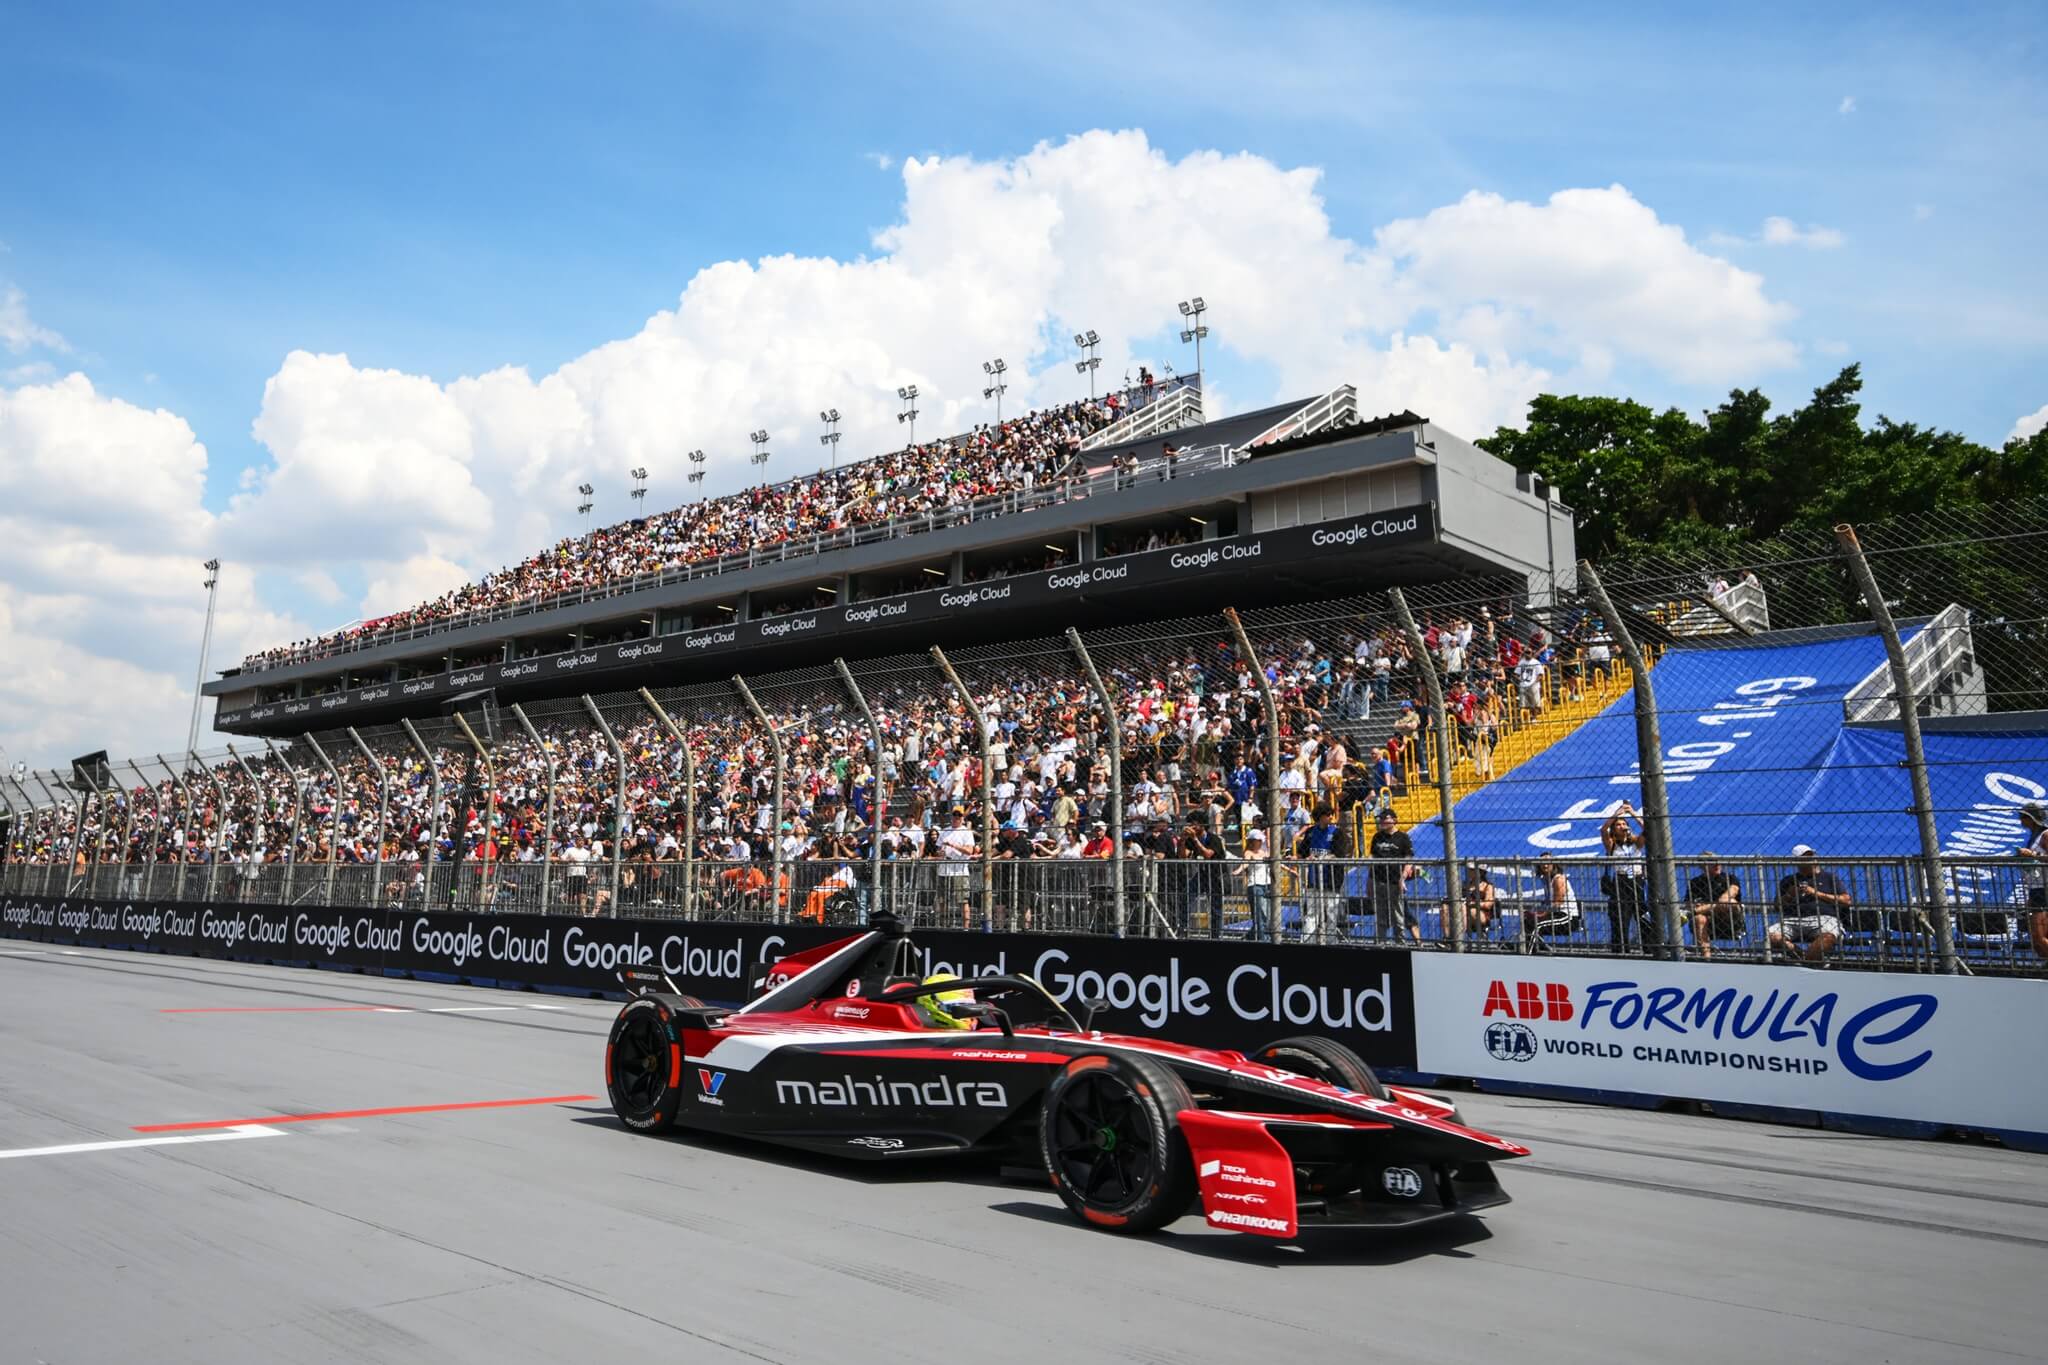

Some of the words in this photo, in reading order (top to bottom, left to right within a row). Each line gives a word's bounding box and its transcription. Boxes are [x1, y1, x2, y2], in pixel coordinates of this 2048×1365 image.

[1312, 525, 1368, 547] Google
[1371, 514, 1417, 536] Cloud
[1171, 550, 1218, 568] Google
[1221, 540, 1261, 560] Cloud
[1048, 569, 1091, 589] Google
[1093, 563, 1128, 582] Cloud
[939, 587, 978, 606] Google
[979, 582, 1010, 600] Cloud
[845, 603, 878, 622] Google
[880, 598, 906, 616] Cloud
[686, 634, 712, 648] Google
[713, 628, 735, 643] Cloud
[761, 620, 791, 636] Google
[791, 616, 816, 632] Cloud
[557, 656, 578, 668] Google
[580, 653, 597, 664] Cloud
[618, 646, 641, 659] Google
[643, 643, 662, 654] Cloud
[450, 675, 468, 686] Google
[469, 672, 483, 682] Cloud
[501, 666, 521, 678] Google
[522, 662, 538, 674] Cloud
[403, 682, 420, 694] Google
[421, 679, 435, 690] Cloud
[4, 900, 30, 928] Google
[31, 904, 54, 925] Cloud
[58, 903, 89, 934] Google
[91, 907, 118, 930] Cloud
[123, 905, 161, 939] Google
[164, 910, 196, 936] Cloud
[202, 910, 245, 947] Google
[249, 914, 288, 943] Cloud
[295, 914, 350, 955] Google
[355, 918, 402, 951] Cloud
[413, 918, 482, 966] Google
[489, 926, 549, 964] Cloud
[662, 936, 742, 978] Cloud
[1033, 949, 1210, 1029] Google
[1227, 965, 1392, 1031] Cloud
[1482, 980, 1574, 1022] ABB
[1580, 981, 1839, 1047] FORMULA
[952, 1050, 1027, 1060] mahindra
[1544, 1039, 1623, 1058] WORLD
[1633, 1046, 1829, 1076] CHAMPIONSHIP
[776, 1075, 1008, 1107] mahindra
[1221, 1174, 1276, 1188] mahindra
[1222, 1165, 1246, 1174] TECH
